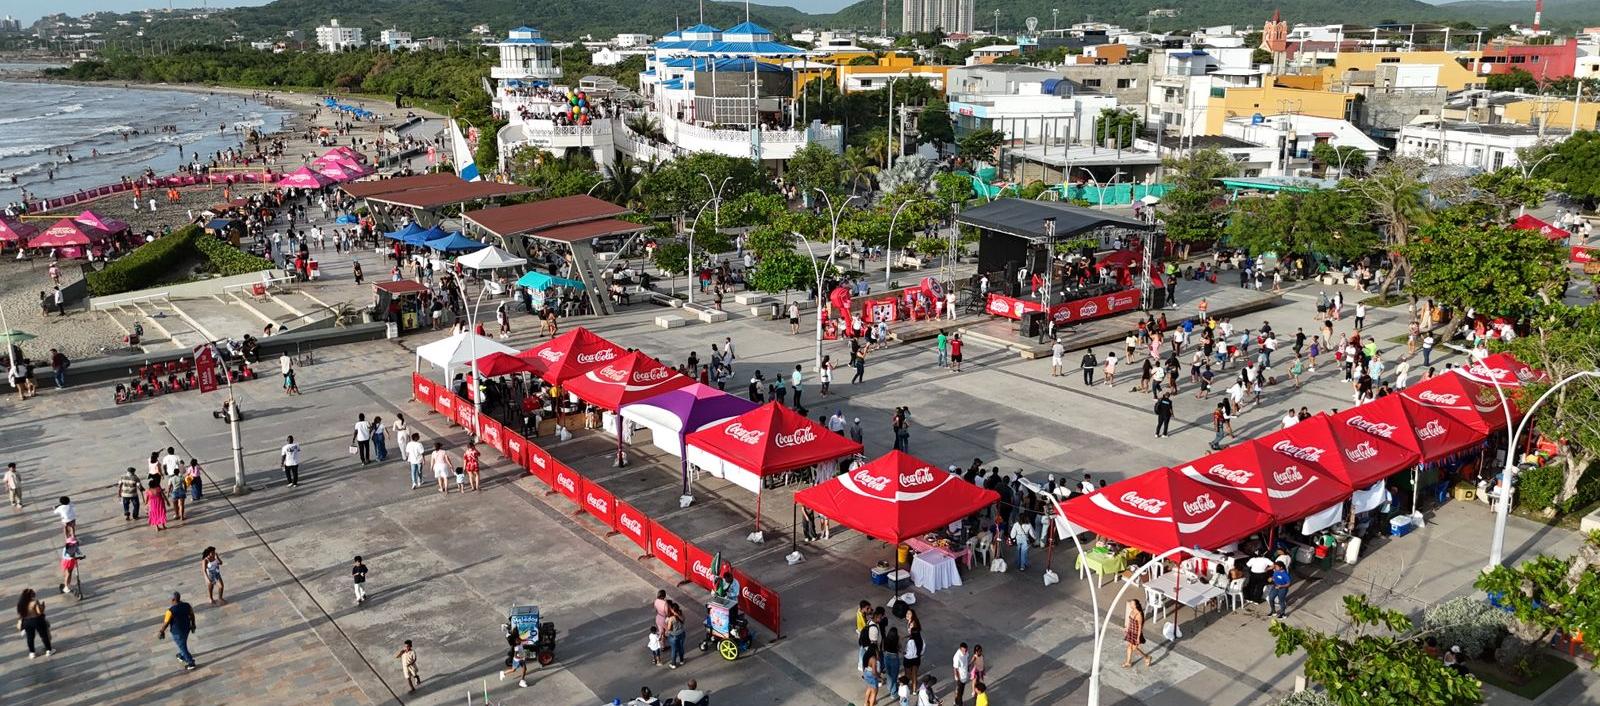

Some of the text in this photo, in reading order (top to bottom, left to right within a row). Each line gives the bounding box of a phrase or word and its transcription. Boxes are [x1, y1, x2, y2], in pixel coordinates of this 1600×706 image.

[538, 348, 564, 362] Coca-Cola
[577, 348, 617, 364] Coca-Cola
[600, 365, 629, 381] Coca-Cola
[633, 366, 669, 382] Coca-Cola
[1419, 390, 1461, 405] Coca-Cola
[725, 422, 765, 445] Coca-Cola
[775, 425, 817, 447] Coca-Cola
[1346, 415, 1398, 438] Coca-Cola
[1414, 419, 1446, 440] Coca-Cola
[1272, 440, 1326, 462] Coca-Cola
[1345, 441, 1378, 462] Coca-Cola
[557, 473, 575, 493] Coca-Cola
[854, 470, 892, 491] Coca-Cola
[899, 467, 934, 487] Coca-Cola
[1208, 463, 1254, 484] Coca-Cola
[1273, 465, 1303, 485] Coca-Cola
[587, 493, 607, 514] Coca-Cola
[1120, 491, 1167, 514] Coca-Cola
[1183, 493, 1216, 516] Coca-Cola
[620, 513, 642, 536] Coca-Cola
[656, 538, 678, 562] Coca-Cola
[742, 587, 767, 610] Coca-Cola
